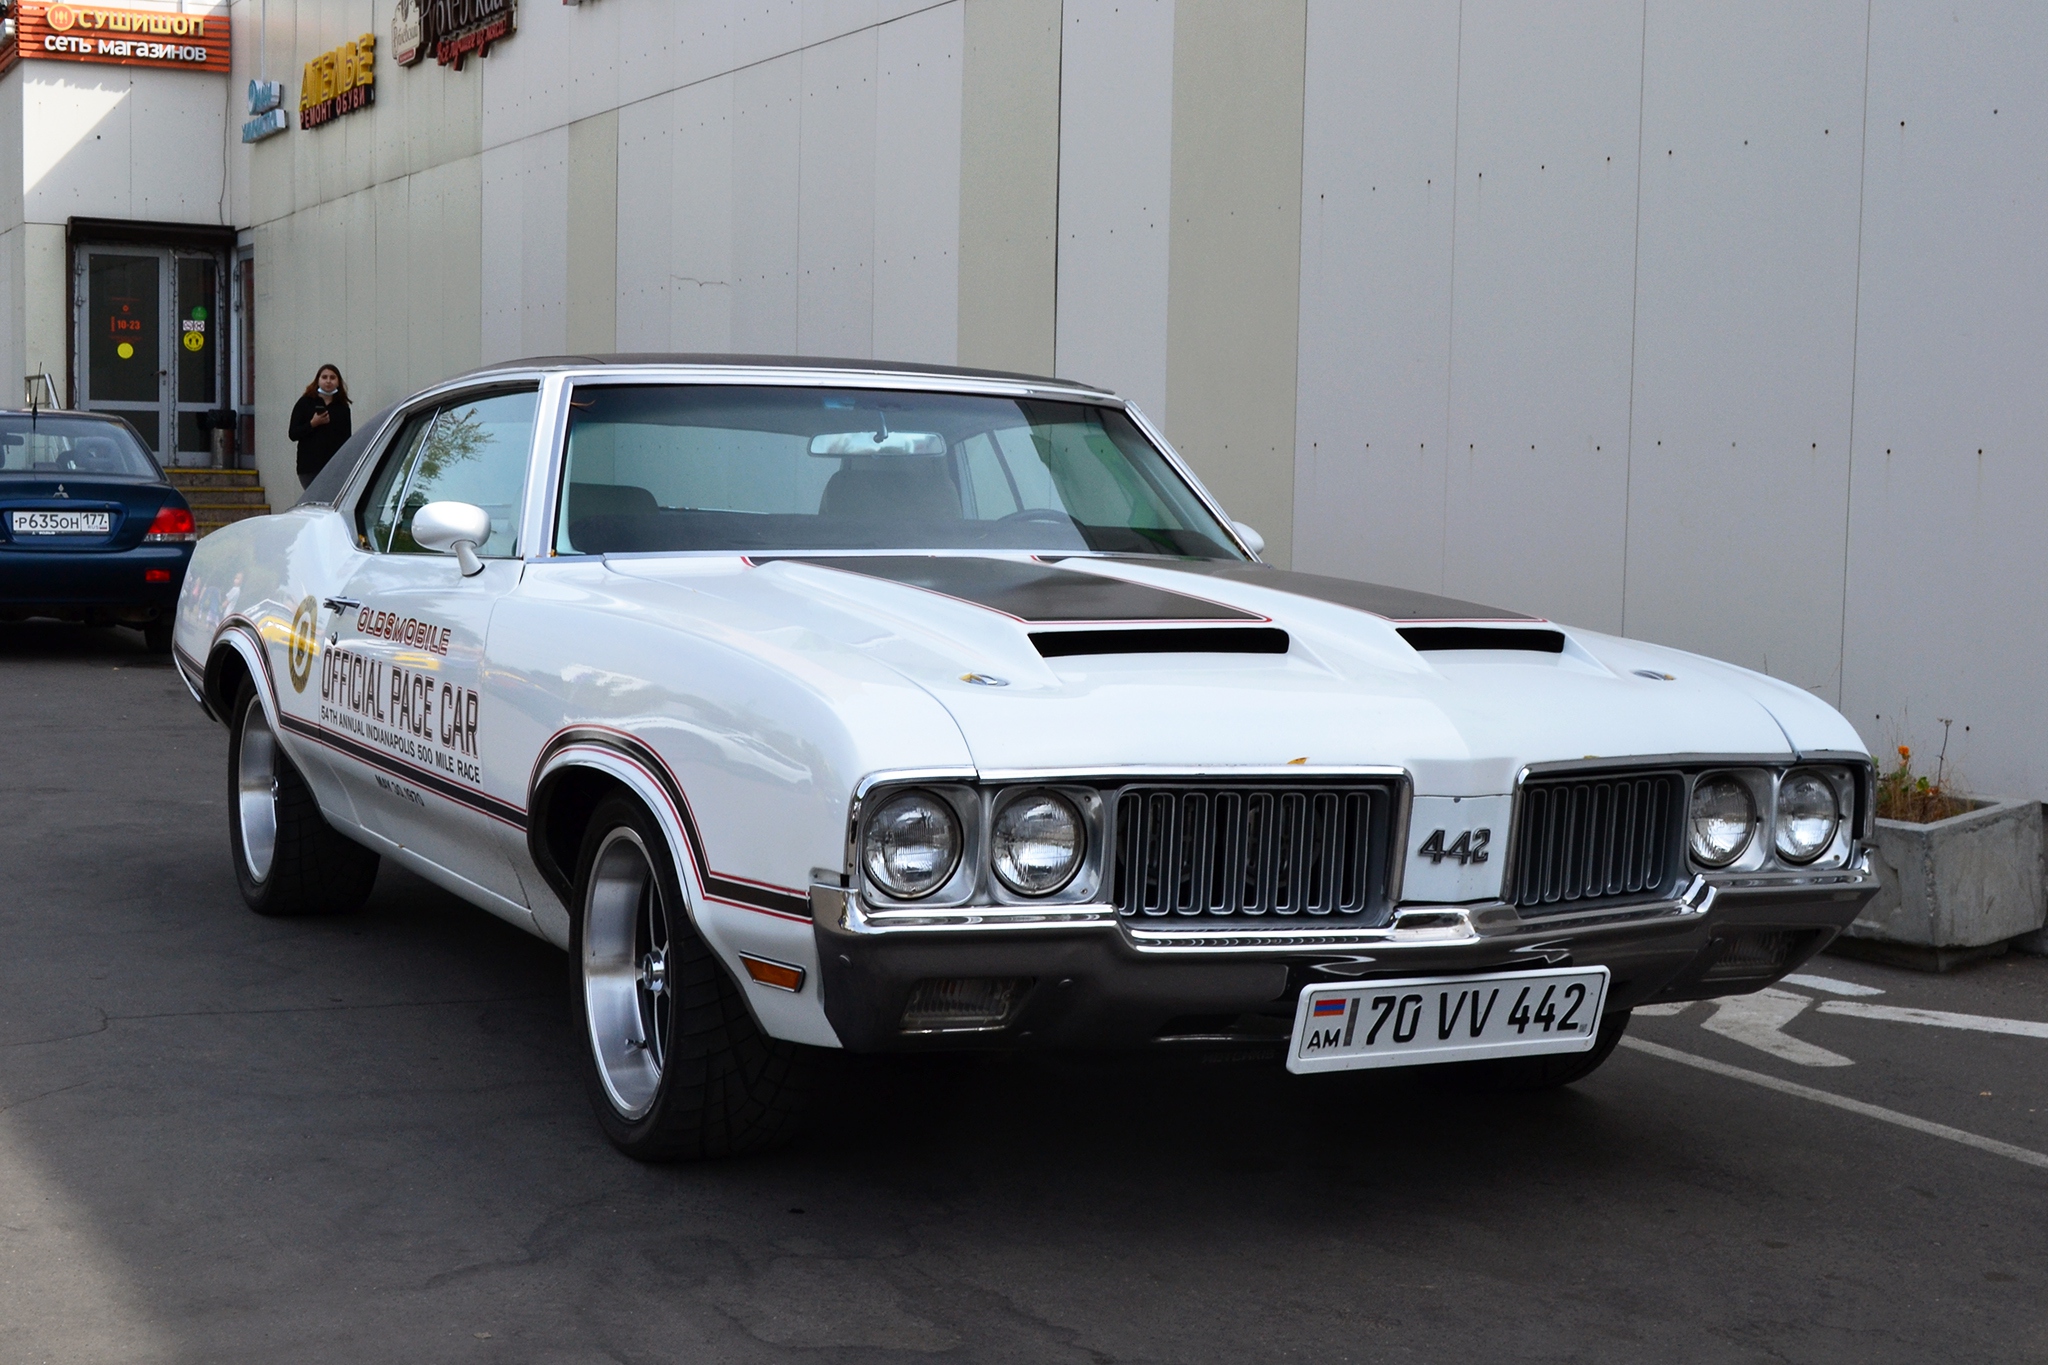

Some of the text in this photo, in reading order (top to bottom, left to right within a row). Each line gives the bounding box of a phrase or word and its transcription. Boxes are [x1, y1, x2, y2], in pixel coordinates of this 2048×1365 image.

[44, 34, 207, 61] сеть магазинов
[299, 33, 374, 112] АТЕЛЬЕ
[300, 99, 332, 129] РЕМОНТ
[335, 84, 366, 116] ОБУВИ
[117, 320, 141, 330] 10-23
[83, 513, 104, 525] 177
[357, 606, 451, 656] OLDSMOBILE
[320, 645, 479, 759] OFFICIAL PACE CAR
[321, 705, 481, 784] 54TH ANNUAL INDIANAPOLIS 500 MILE RACE
[374, 774, 392, 790] MAY
[1416, 828, 1492, 865] 442
[1366, 982, 1587, 1046] 70 VV 442
[1306, 1028, 1341, 1050] AM
